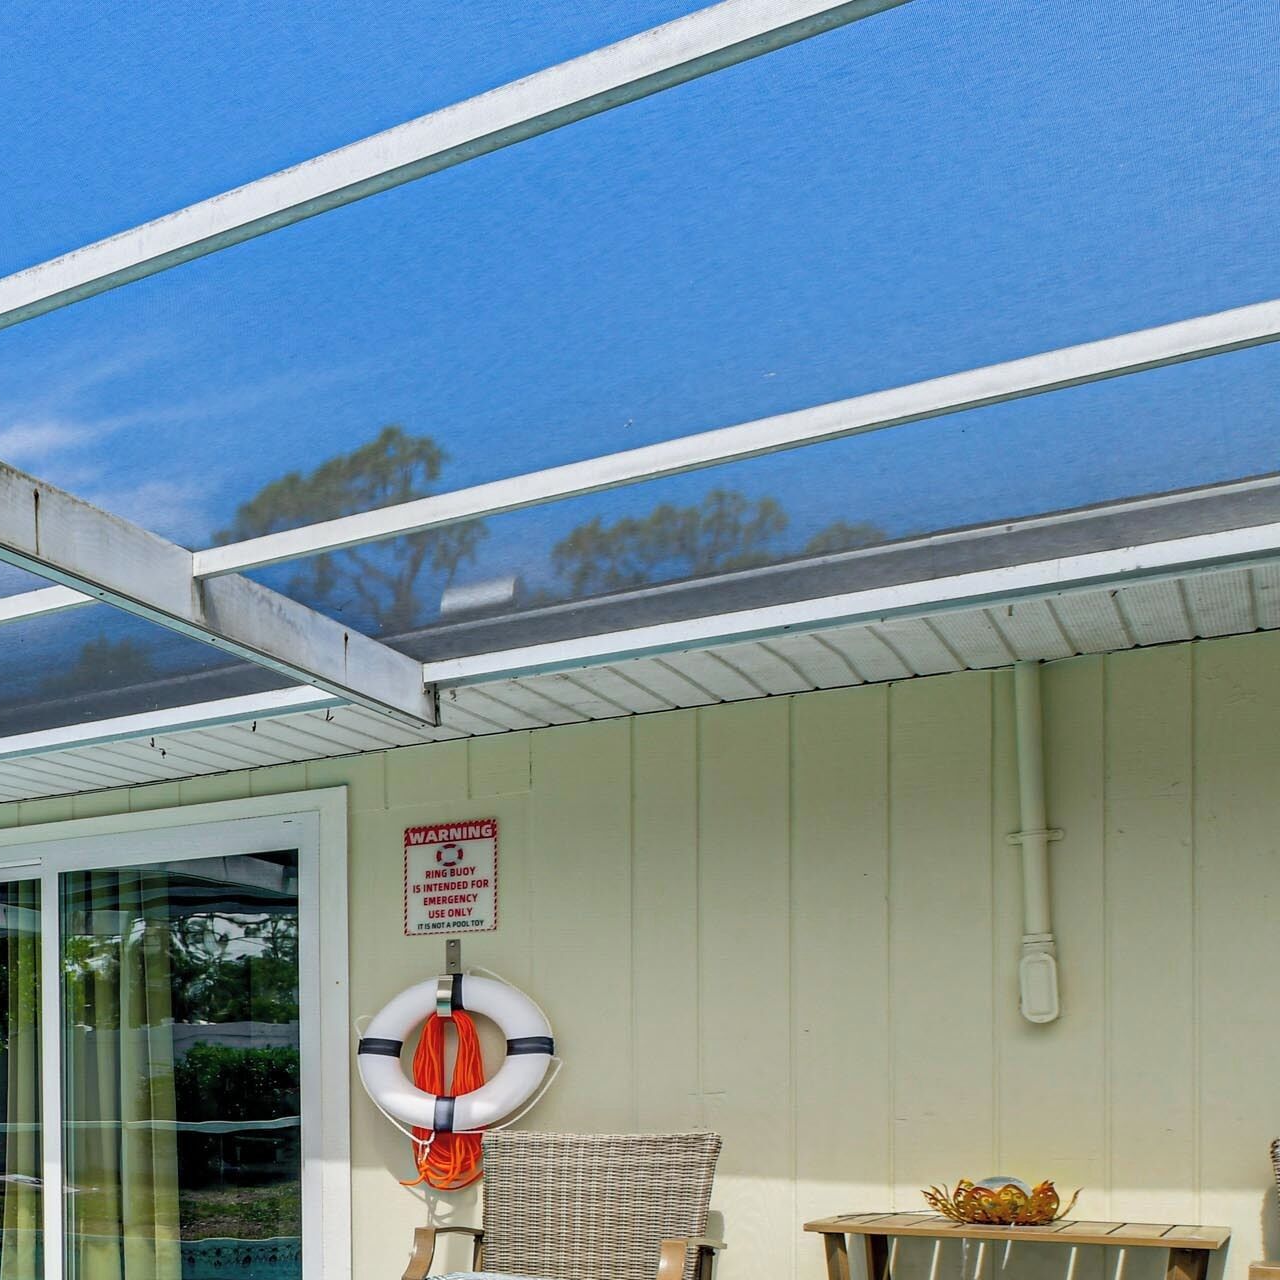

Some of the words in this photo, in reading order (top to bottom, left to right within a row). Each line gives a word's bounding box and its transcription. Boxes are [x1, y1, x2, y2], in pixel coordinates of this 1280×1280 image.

[409, 825, 492, 844] WARNING
[425, 868, 447, 879] RING
[450, 866, 476, 877] BUOY
[413, 884, 421, 893] IS
[424, 881, 468, 892] INTENDED
[471, 879, 489, 889] FOR
[424, 894, 478, 906] EMERGENCY
[428, 909, 445, 919] USE
[448, 907, 473, 918] ONLY
[424, 922, 431, 930] IS
[432, 921, 445, 929] NOT
[452, 920, 470, 928] POOL
[471, 919, 484, 927] TOY
